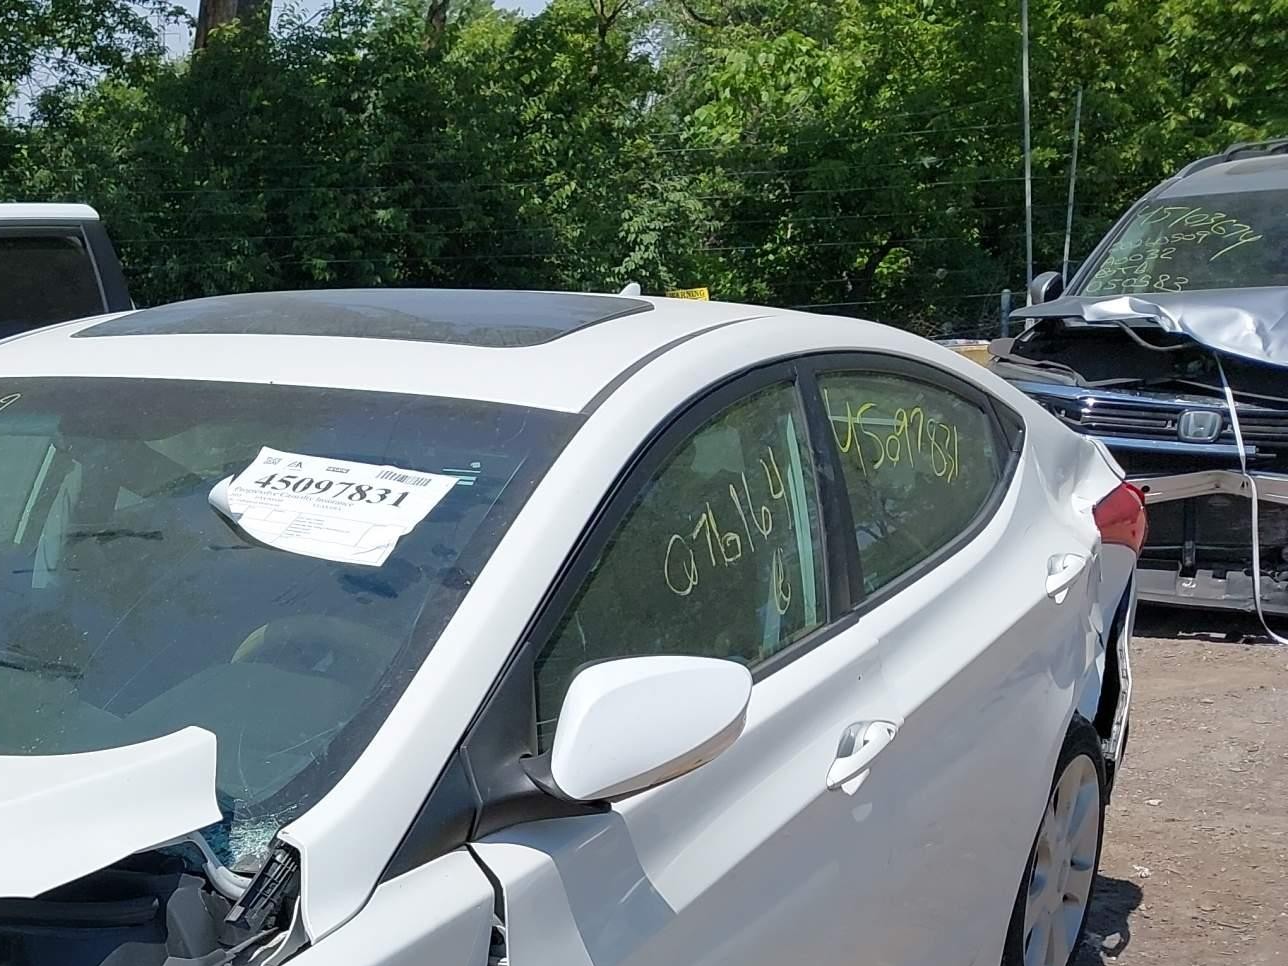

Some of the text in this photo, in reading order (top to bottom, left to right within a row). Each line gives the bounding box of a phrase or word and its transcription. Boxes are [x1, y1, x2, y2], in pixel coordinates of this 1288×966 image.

[823, 388, 960, 484] 45097831
[254, 473, 410, 508] 45097831
[664, 446, 792, 596] 076164
